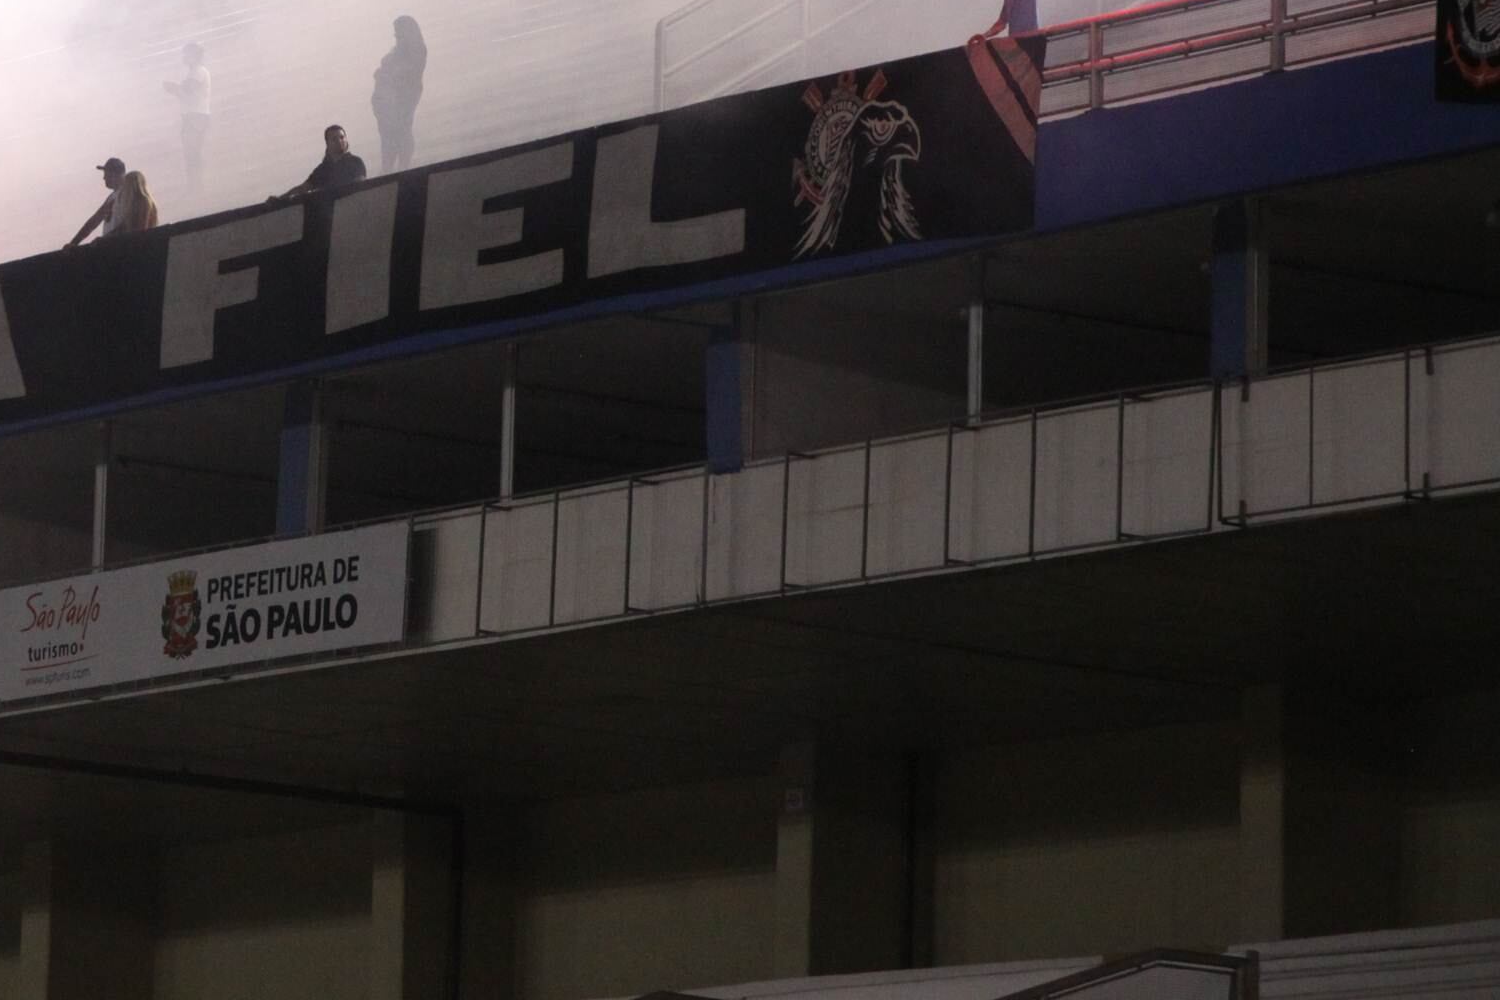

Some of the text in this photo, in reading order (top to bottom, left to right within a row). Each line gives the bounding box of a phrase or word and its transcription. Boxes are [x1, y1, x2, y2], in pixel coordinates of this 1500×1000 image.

[159, 124, 746, 369] FIEL
[206, 555, 360, 602] PREFEITURA DE
[19, 584, 100, 640] São Paulo
[205, 592, 358, 650] SÃO PAULO
[28, 642, 78, 662] turismo
